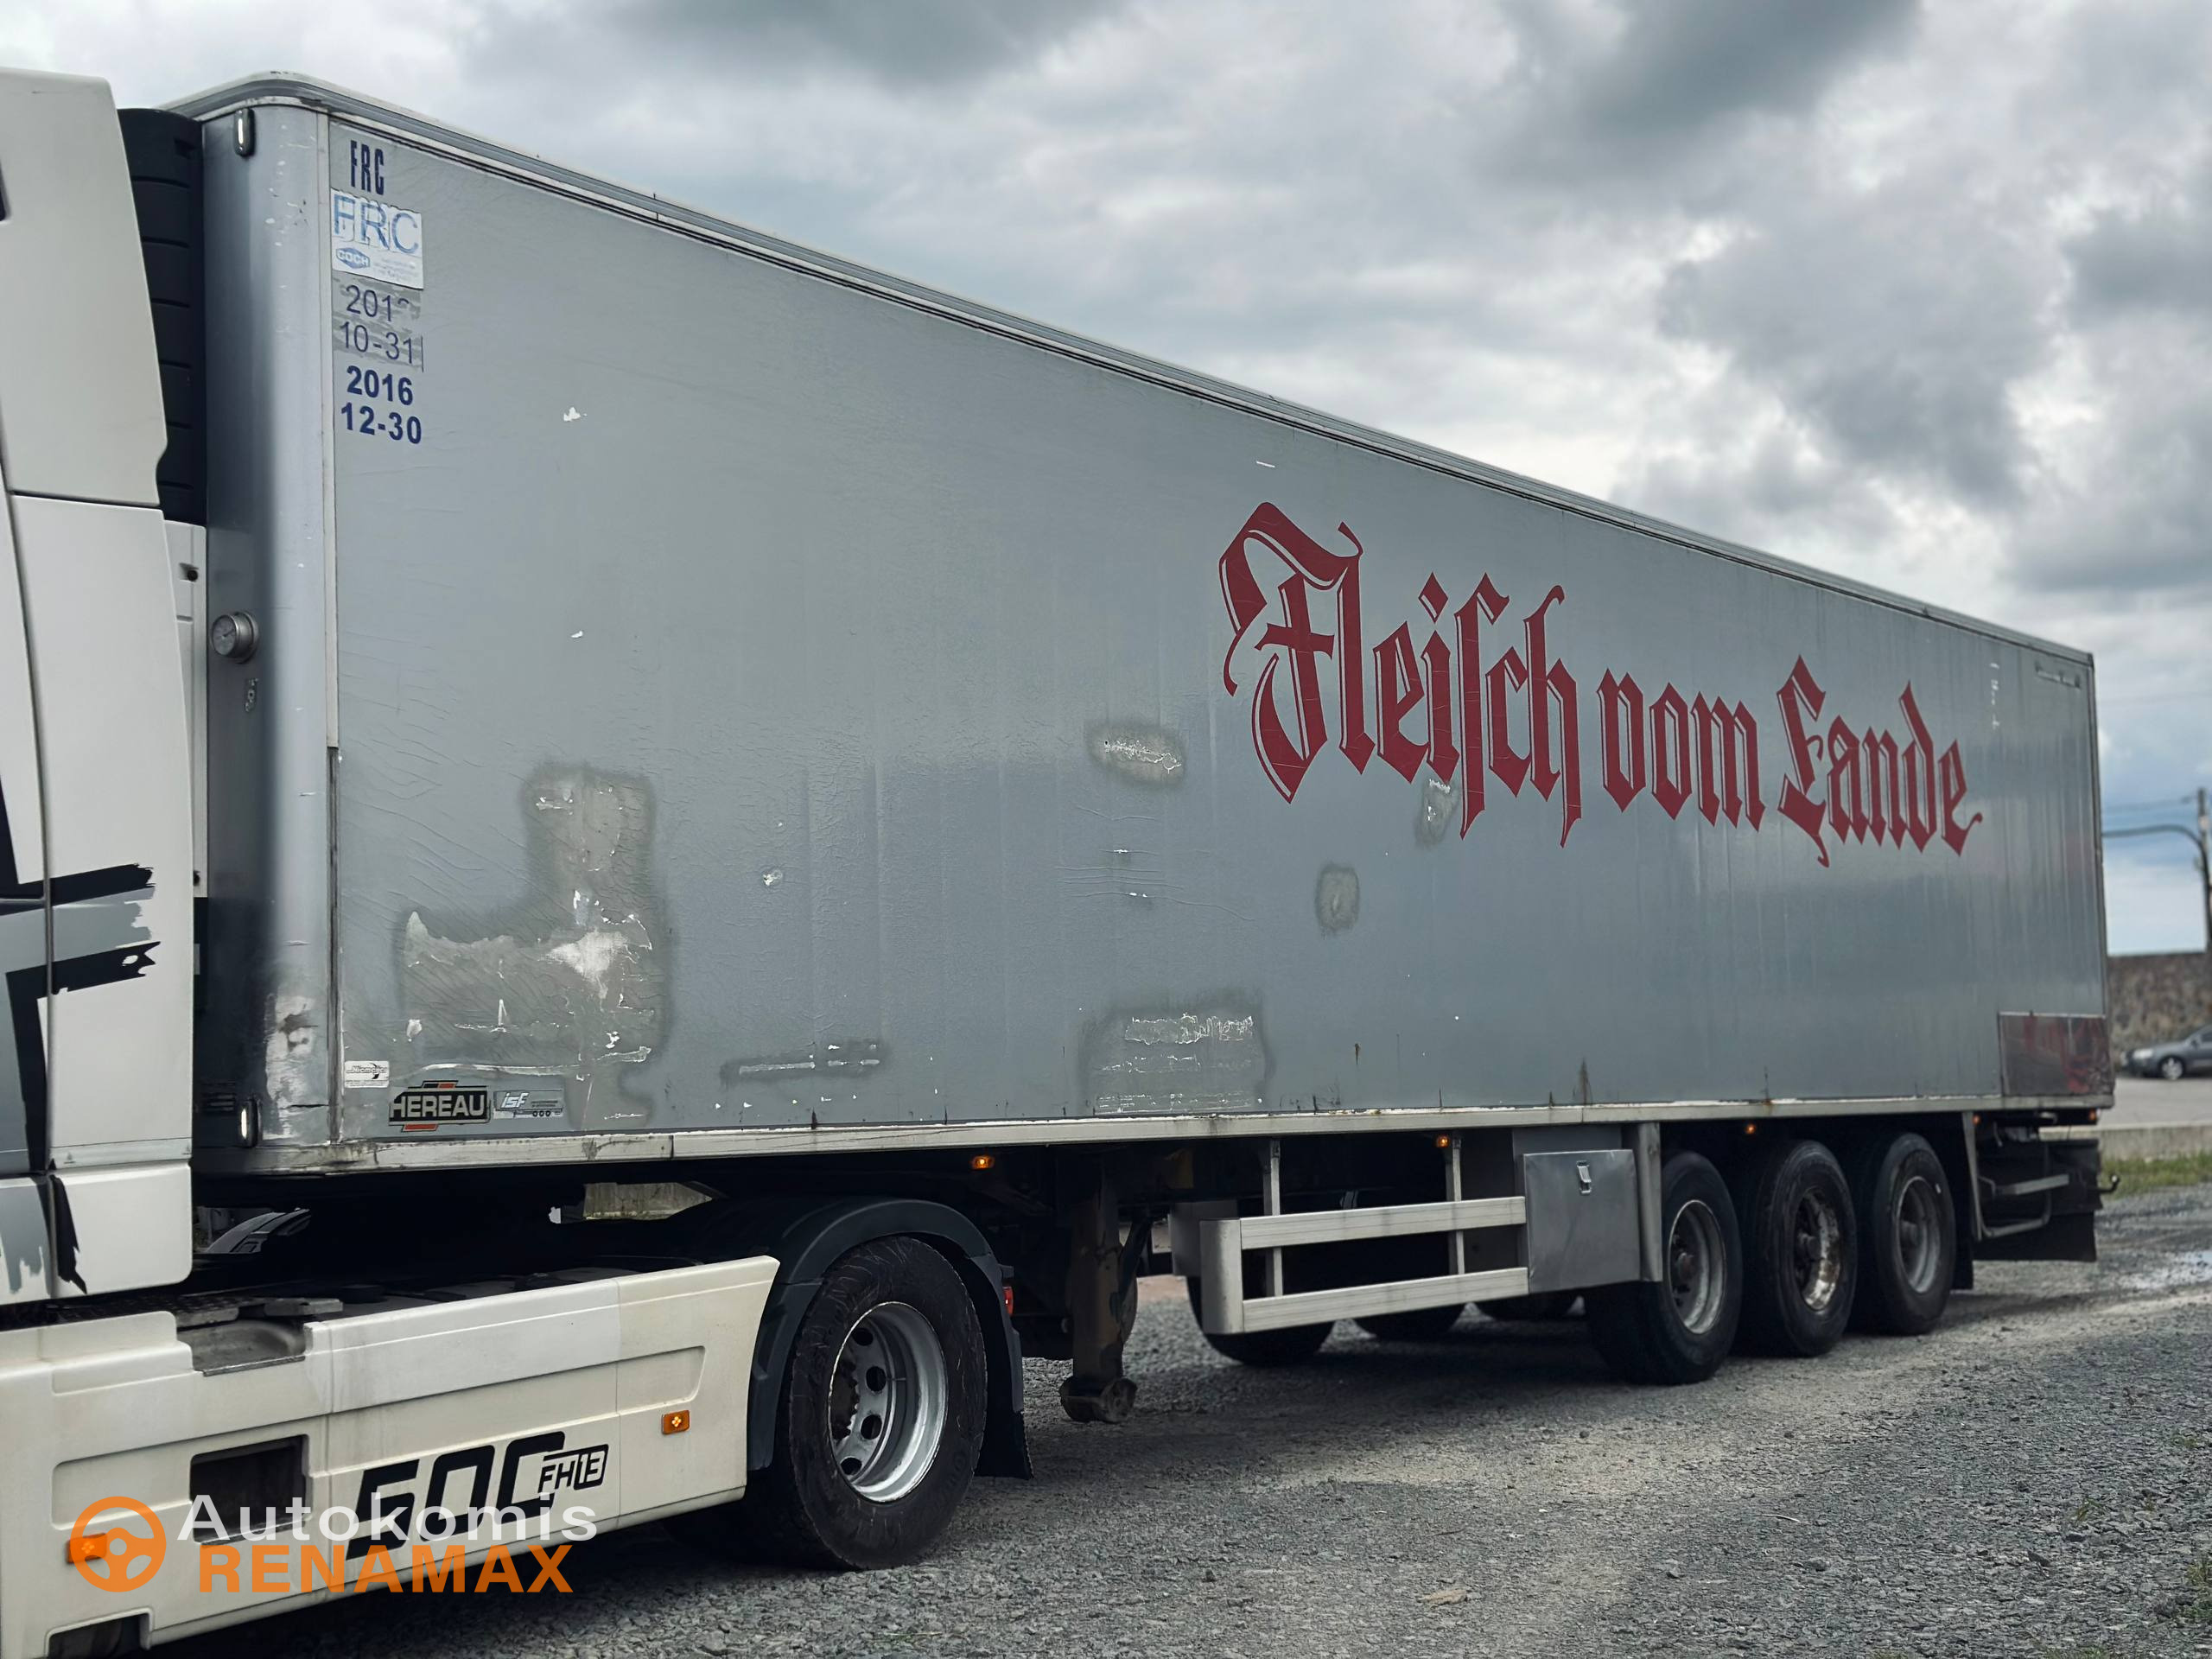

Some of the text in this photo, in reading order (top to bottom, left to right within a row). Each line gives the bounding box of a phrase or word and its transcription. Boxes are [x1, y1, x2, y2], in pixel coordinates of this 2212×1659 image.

[350, 140, 385, 195] FRC
[334, 194, 419, 254] FRC
[346, 284, 410, 322] 201
[340, 321, 413, 364] 10-31
[346, 365, 413, 406] 2016
[341, 402, 423, 445] 12-30
[1597, 667, 1765, 831] vom
[1777, 654, 1982, 867] Lande
[537, 1446, 608, 1493] FH13
